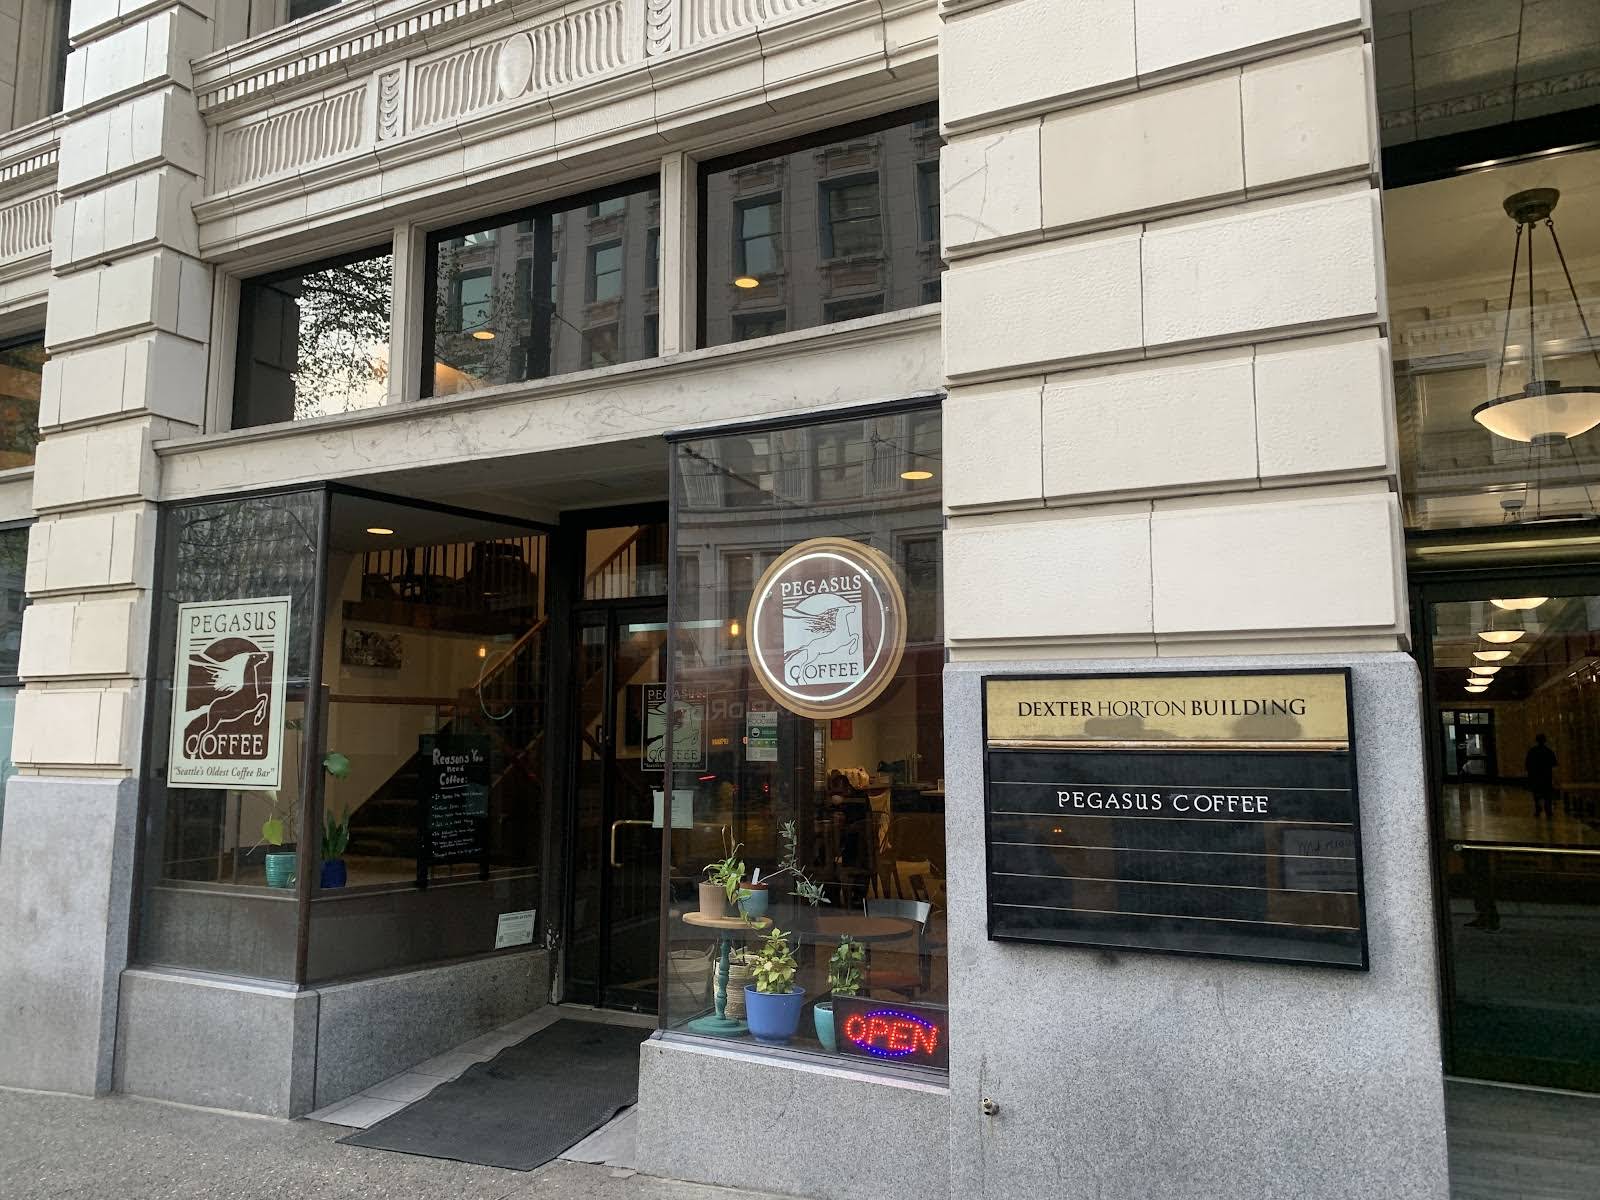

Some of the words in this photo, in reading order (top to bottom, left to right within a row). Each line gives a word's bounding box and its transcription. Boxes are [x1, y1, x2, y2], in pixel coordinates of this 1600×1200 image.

[781, 575, 861, 597] PEGASUS
[190, 610, 277, 634] PEGASUS
[790, 662, 859, 681] COFFEE
[1018, 701, 1094, 717] DEXTER
[1098, 700, 1186, 718] HORTON
[1191, 698, 1306, 716] BUILDING
[185, 734, 264, 757] COFFEE
[432, 748, 470, 766] Reasons
[206, 766, 229, 776] Oldest
[231, 767, 254, 780] Coffee
[256, 767, 275, 777] Bar"
[1056, 791, 1162, 811] PEGASUS
[1173, 794, 1269, 814] COFFEE
[846, 1015, 939, 1055] OPEN
